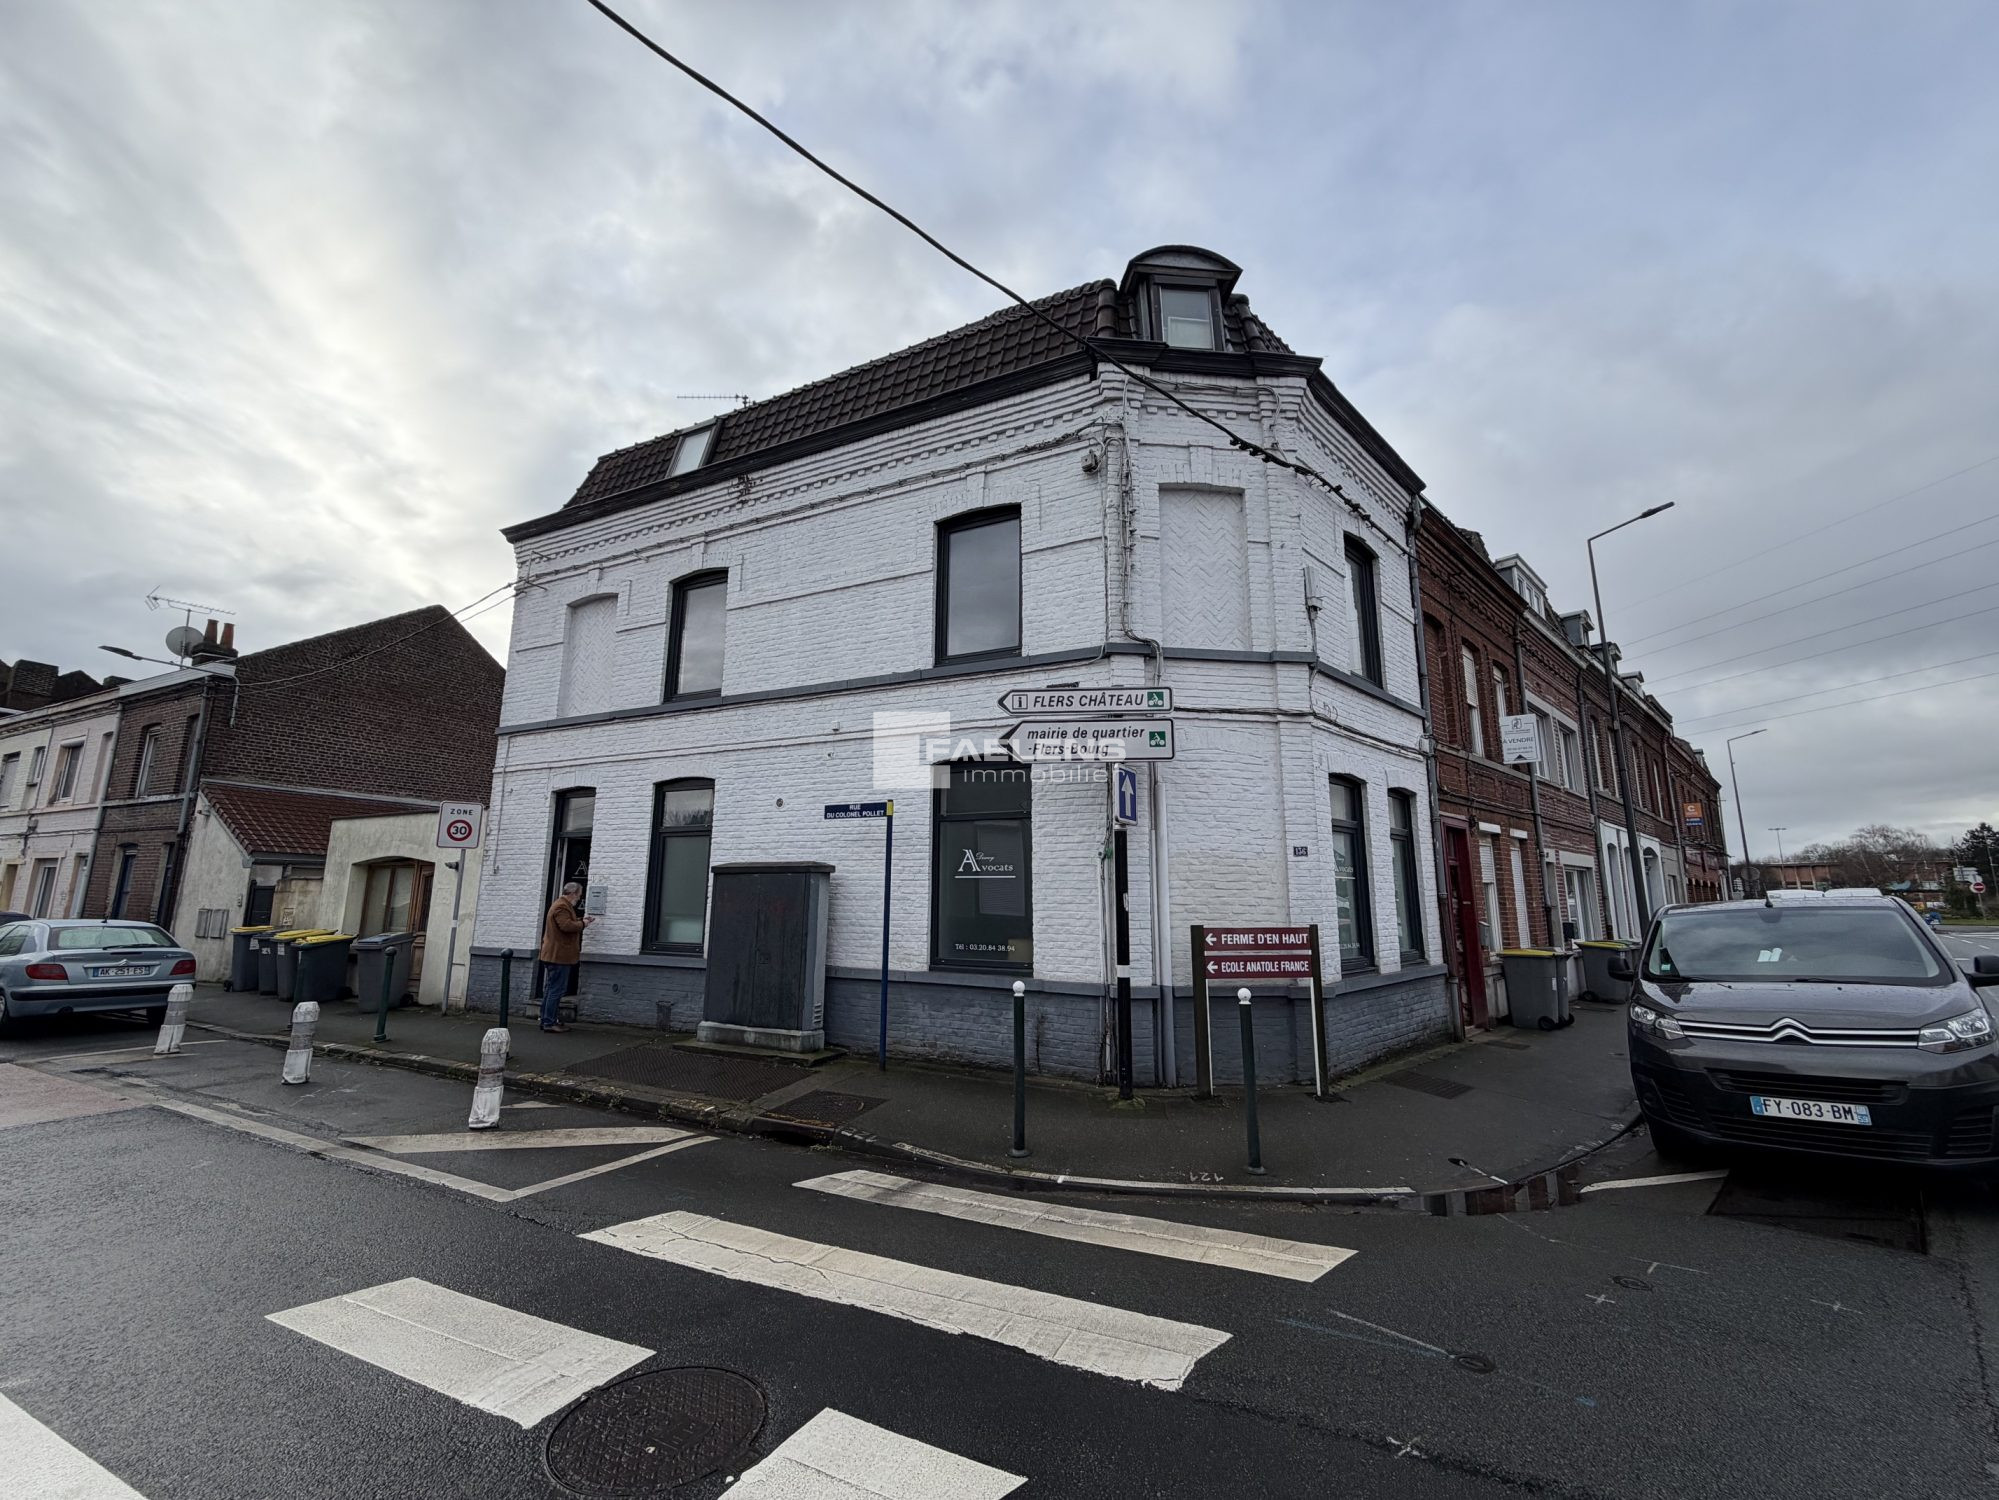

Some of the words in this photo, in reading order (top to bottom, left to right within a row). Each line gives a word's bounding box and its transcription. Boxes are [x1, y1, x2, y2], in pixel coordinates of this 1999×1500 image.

[1033, 694, 1075, 708] FLERS
[1078, 692, 1145, 707] CHÂTEAU
[1027, 727, 1068, 740] mairie
[1072, 726, 1088, 739] de
[1092, 725, 1145, 741] quartier
[450, 808, 474, 816] ZONE
[452, 825, 467, 836] 30
[1221, 933, 1255, 945] FERME
[1257, 933, 1279, 945] D'EN
[1282, 933, 1308, 944] HAUT
[1221, 961, 1245, 973] ECOLE
[1246, 961, 1279, 972] ANATOLE
[1280, 960, 1309, 972] FRANCE
[1761, 1098, 1855, 1121] FY-083-BM
